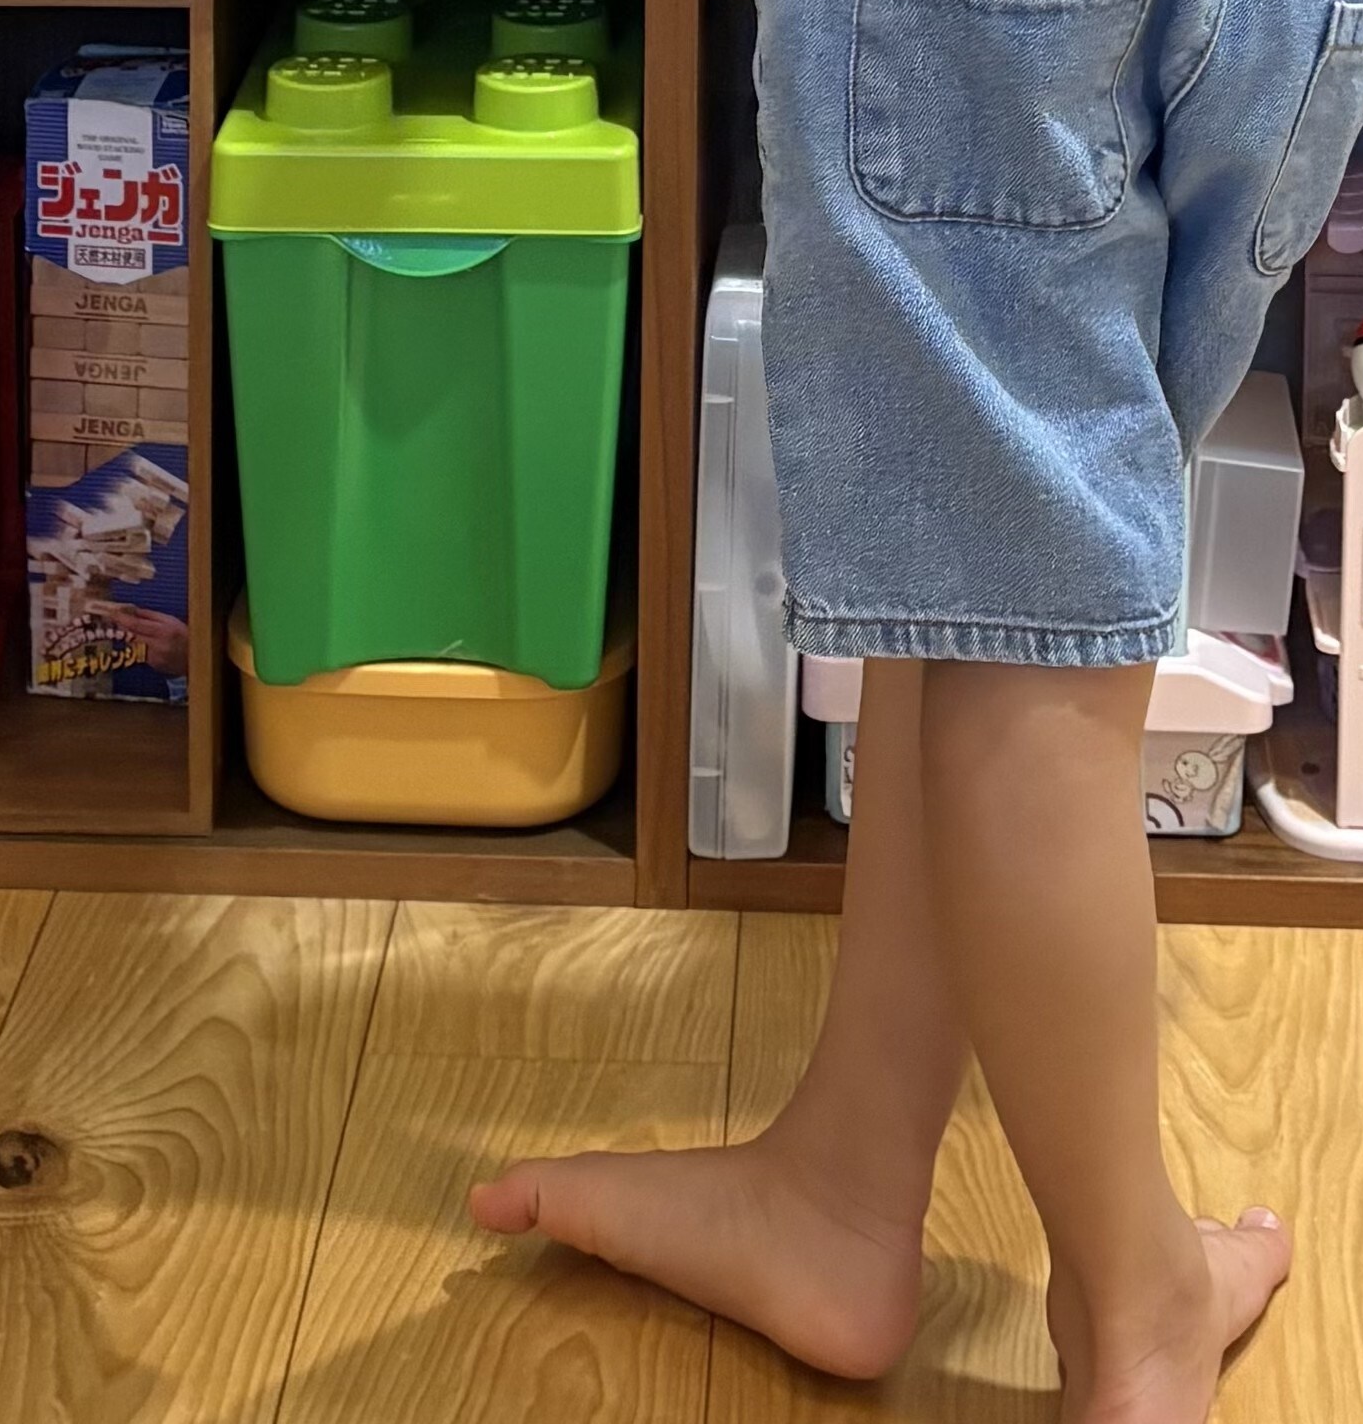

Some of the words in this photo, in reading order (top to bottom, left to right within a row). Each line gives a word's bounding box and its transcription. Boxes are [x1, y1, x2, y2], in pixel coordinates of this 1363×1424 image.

[40, 161, 180, 226] ジェンガ
[75, 224, 145, 244] Jenga
[75, 293, 148, 314] JENGA
[74, 361, 147, 382] JENGA
[73, 418, 145, 439] JENGA
